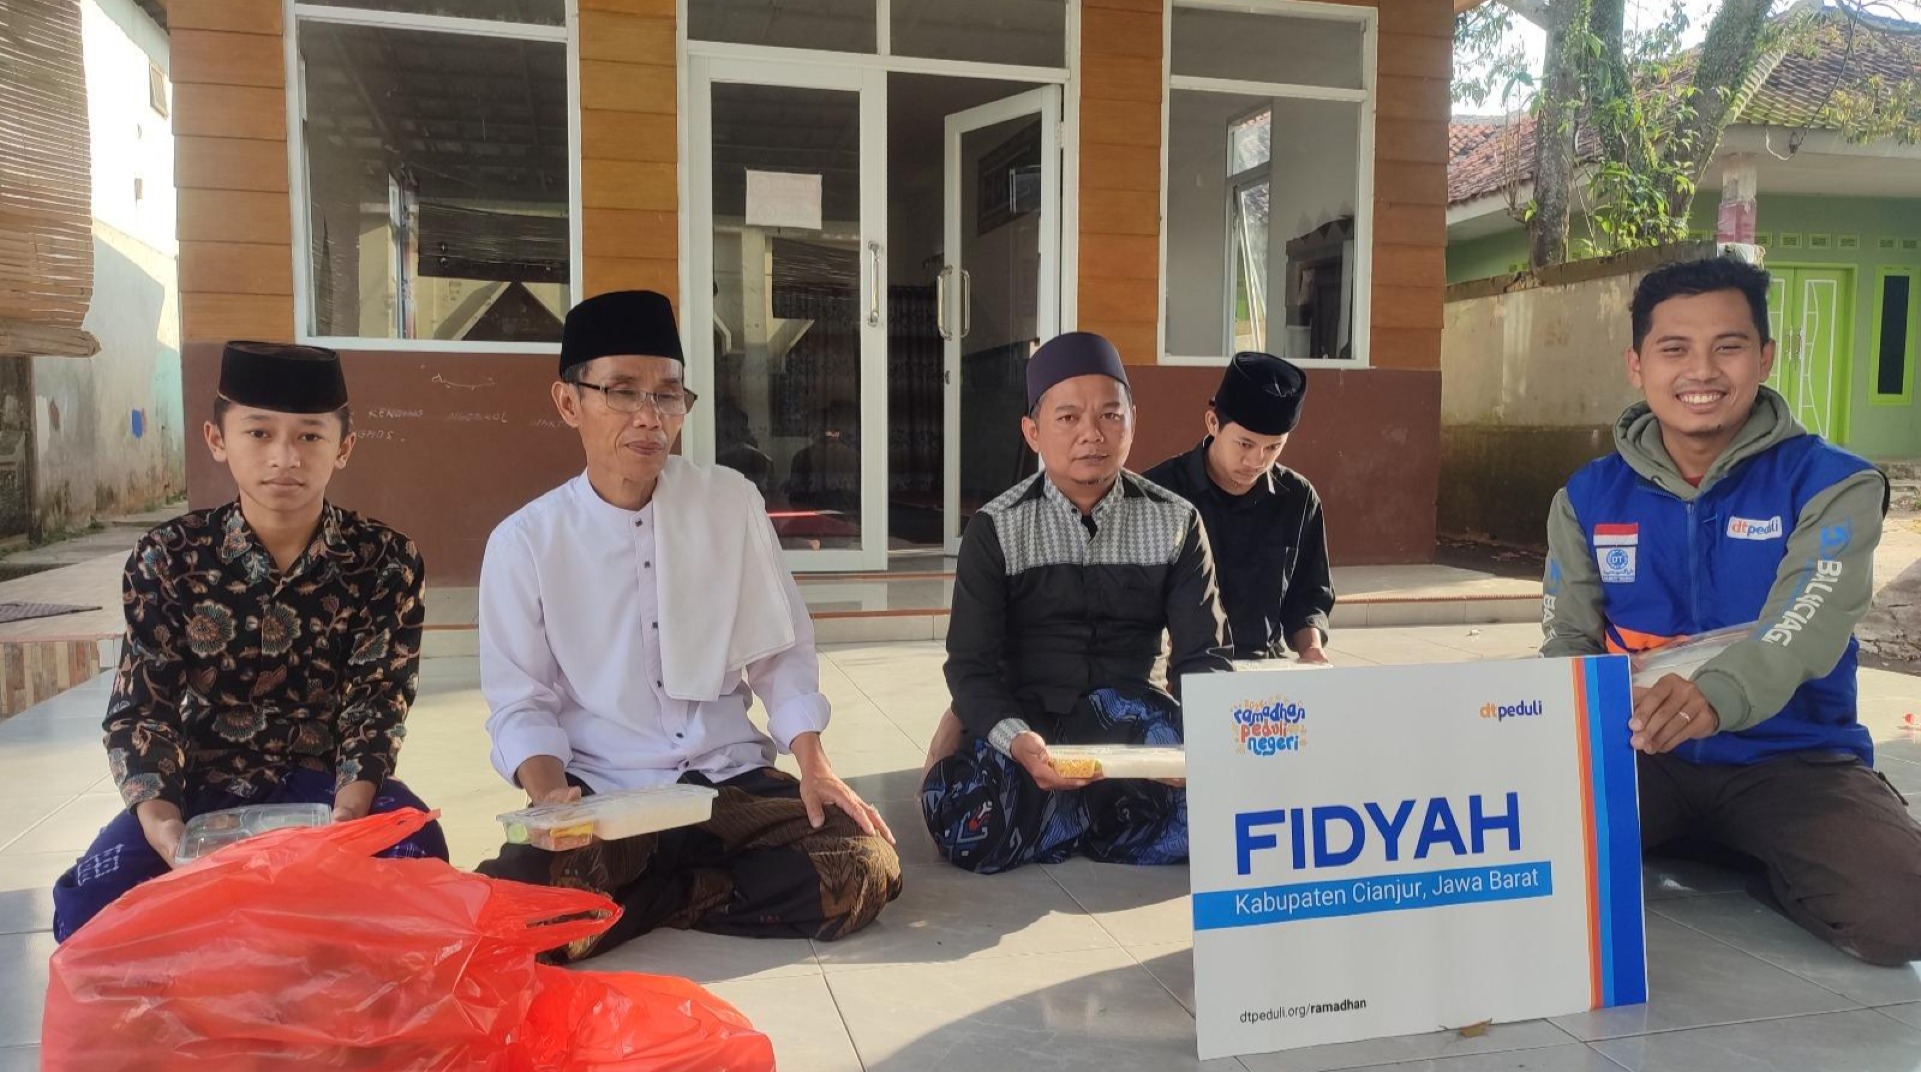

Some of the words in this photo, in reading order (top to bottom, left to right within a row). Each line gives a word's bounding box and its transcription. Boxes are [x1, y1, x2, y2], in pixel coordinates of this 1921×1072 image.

[1233, 702, 1306, 726] ramadhan
[1479, 700, 1542, 722] dtpeduli
[1240, 721, 1288, 743] peduli
[1247, 735, 1299, 756] negeri
[1235, 792, 1521, 875] FIDYAH
[1235, 887, 1346, 915] Kabupaten
[1352, 878, 1427, 912] Cianjur,
[1432, 874, 1483, 897] Jawa
[1489, 867, 1539, 891] Barat
[1239, 998, 1367, 1024] dtpeduli.org/ramadhan
